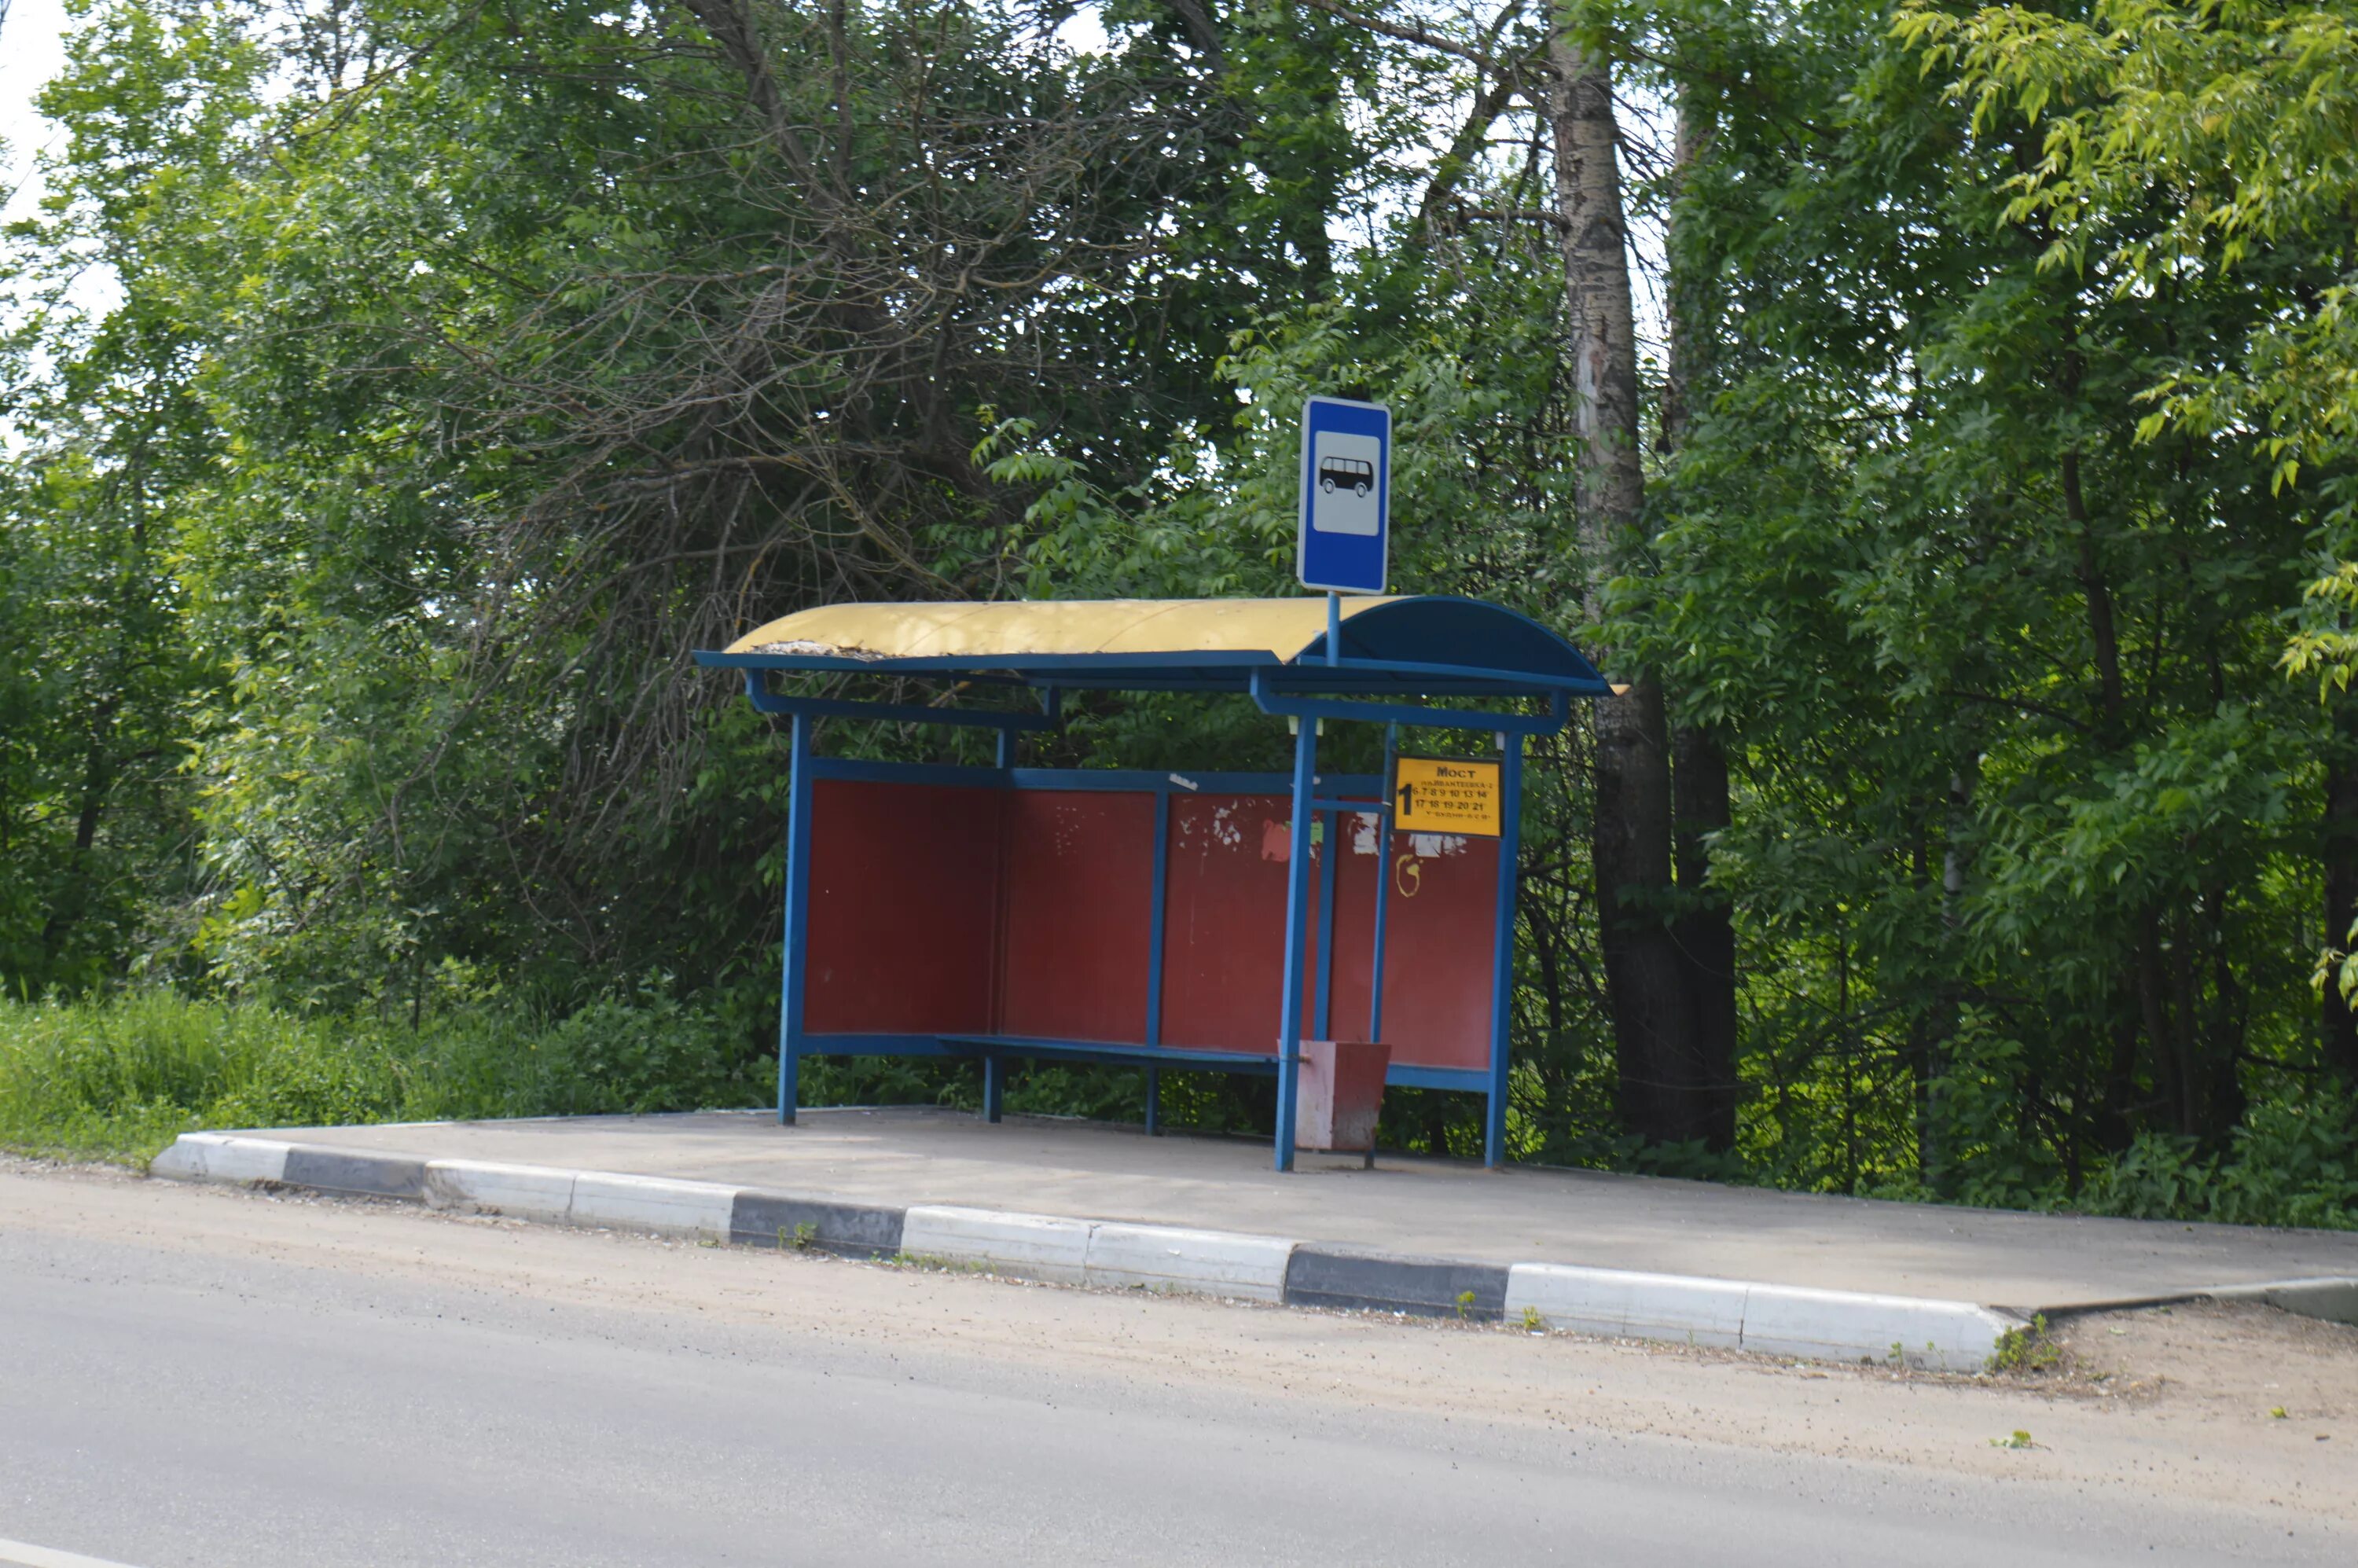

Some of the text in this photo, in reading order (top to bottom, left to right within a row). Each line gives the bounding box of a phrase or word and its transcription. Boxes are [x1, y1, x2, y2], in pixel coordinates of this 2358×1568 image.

[1398, 784, 1412, 815] 1
[1416, 799, 1424, 808] 17
[1457, 801, 1469, 810] 20
[1472, 802, 1483, 810] 21
